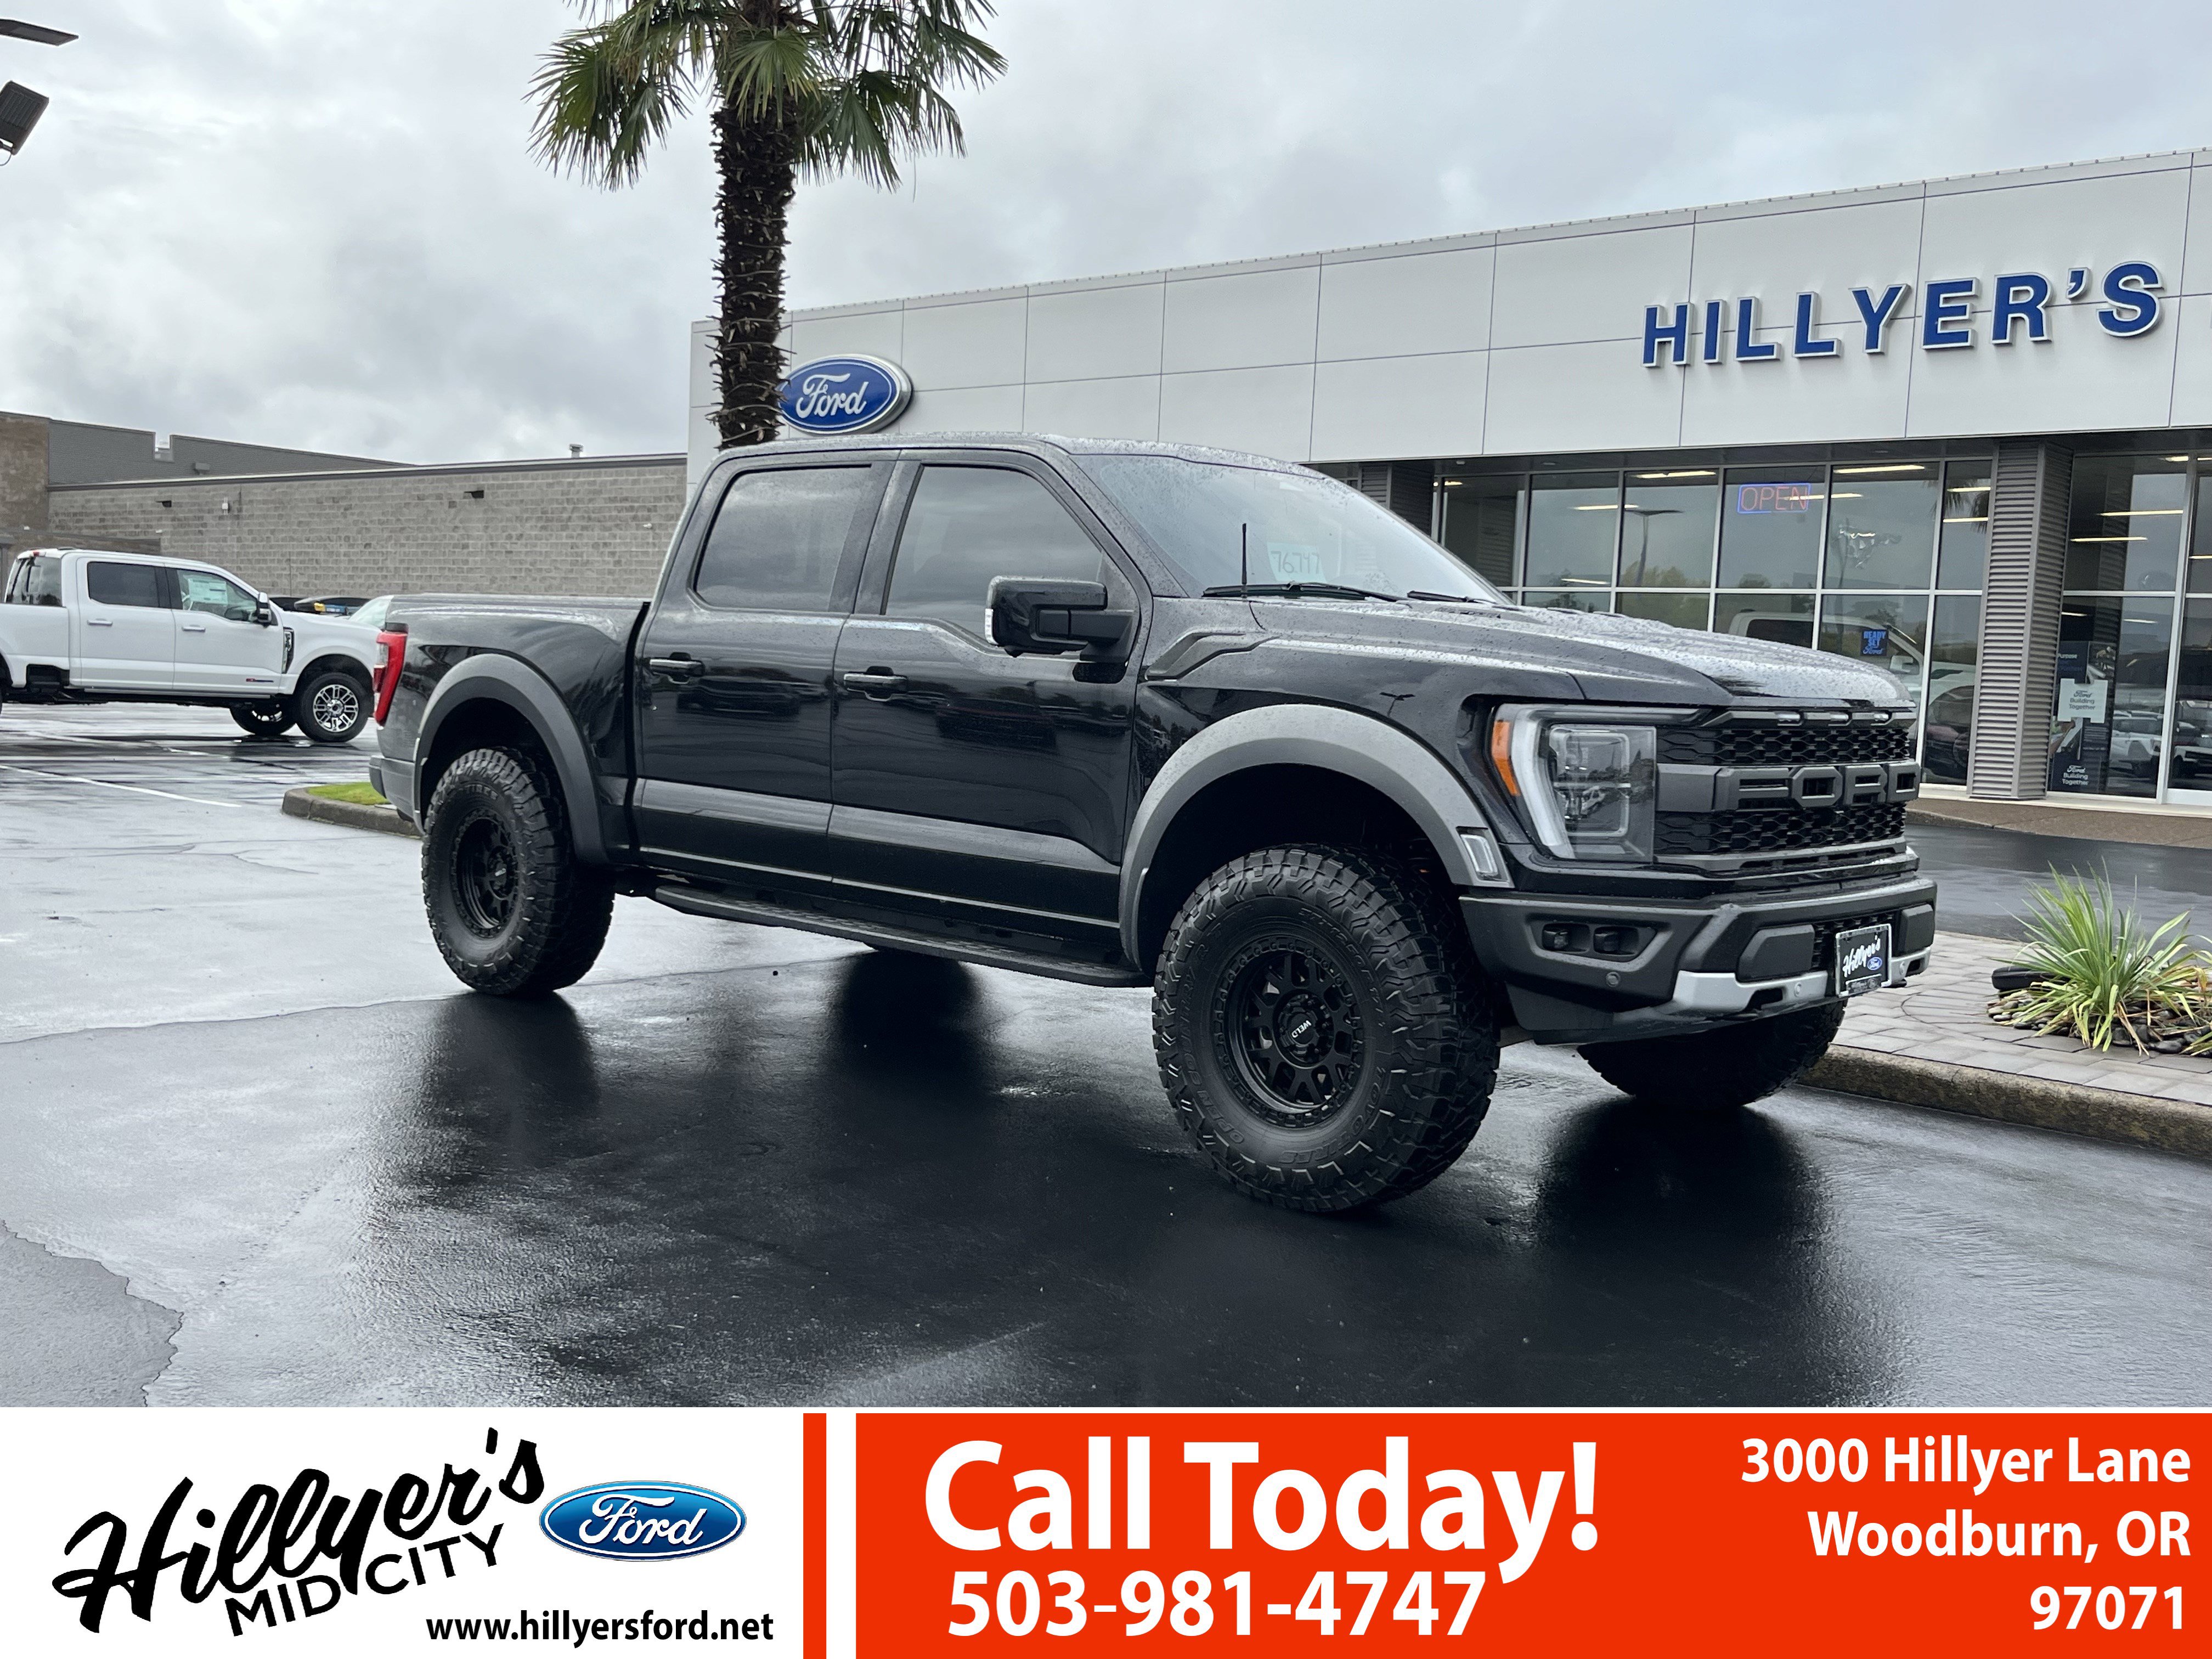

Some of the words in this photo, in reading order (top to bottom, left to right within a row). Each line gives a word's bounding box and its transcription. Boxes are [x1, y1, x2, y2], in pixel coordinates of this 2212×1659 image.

[1641, 261, 2164, 368] HILLYER'S
[795, 373, 869, 419] Ford
[1741, 487, 1808, 511] OPEN
[2073, 690, 2093, 698] Ford
[1715, 764, 1920, 810] FORD
[1291, 1020, 1312, 1038] WELD
